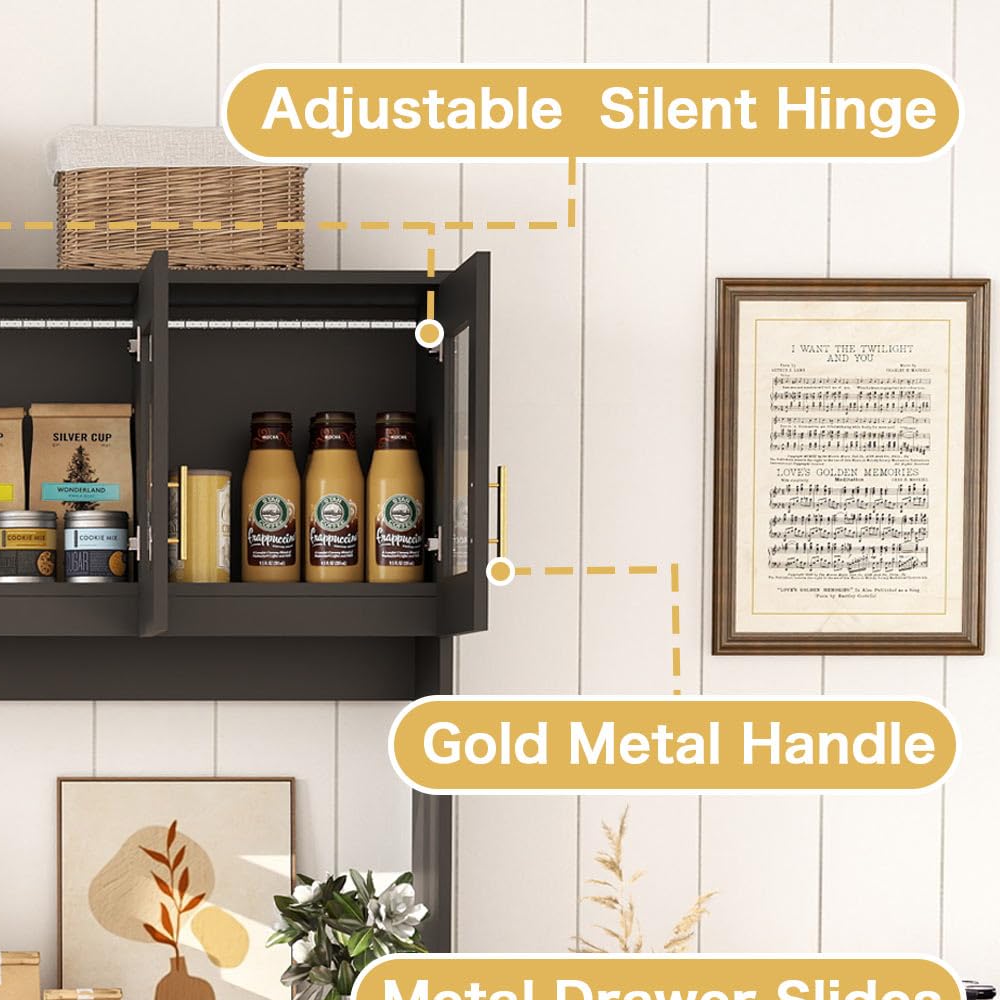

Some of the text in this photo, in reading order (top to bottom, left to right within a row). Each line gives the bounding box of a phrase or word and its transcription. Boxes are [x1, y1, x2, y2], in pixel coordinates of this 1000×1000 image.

[800, 345, 831, 353] WANT
[835, 345, 856, 353] THE
[860, 345, 914, 353] TWILIGHT
[827, 354, 874, 362] AND YOU
[53, 432, 113, 442] SILVER CUP
[816, 468, 858, 477] GOLDEN
[864, 468, 919, 477] MEMORIES
